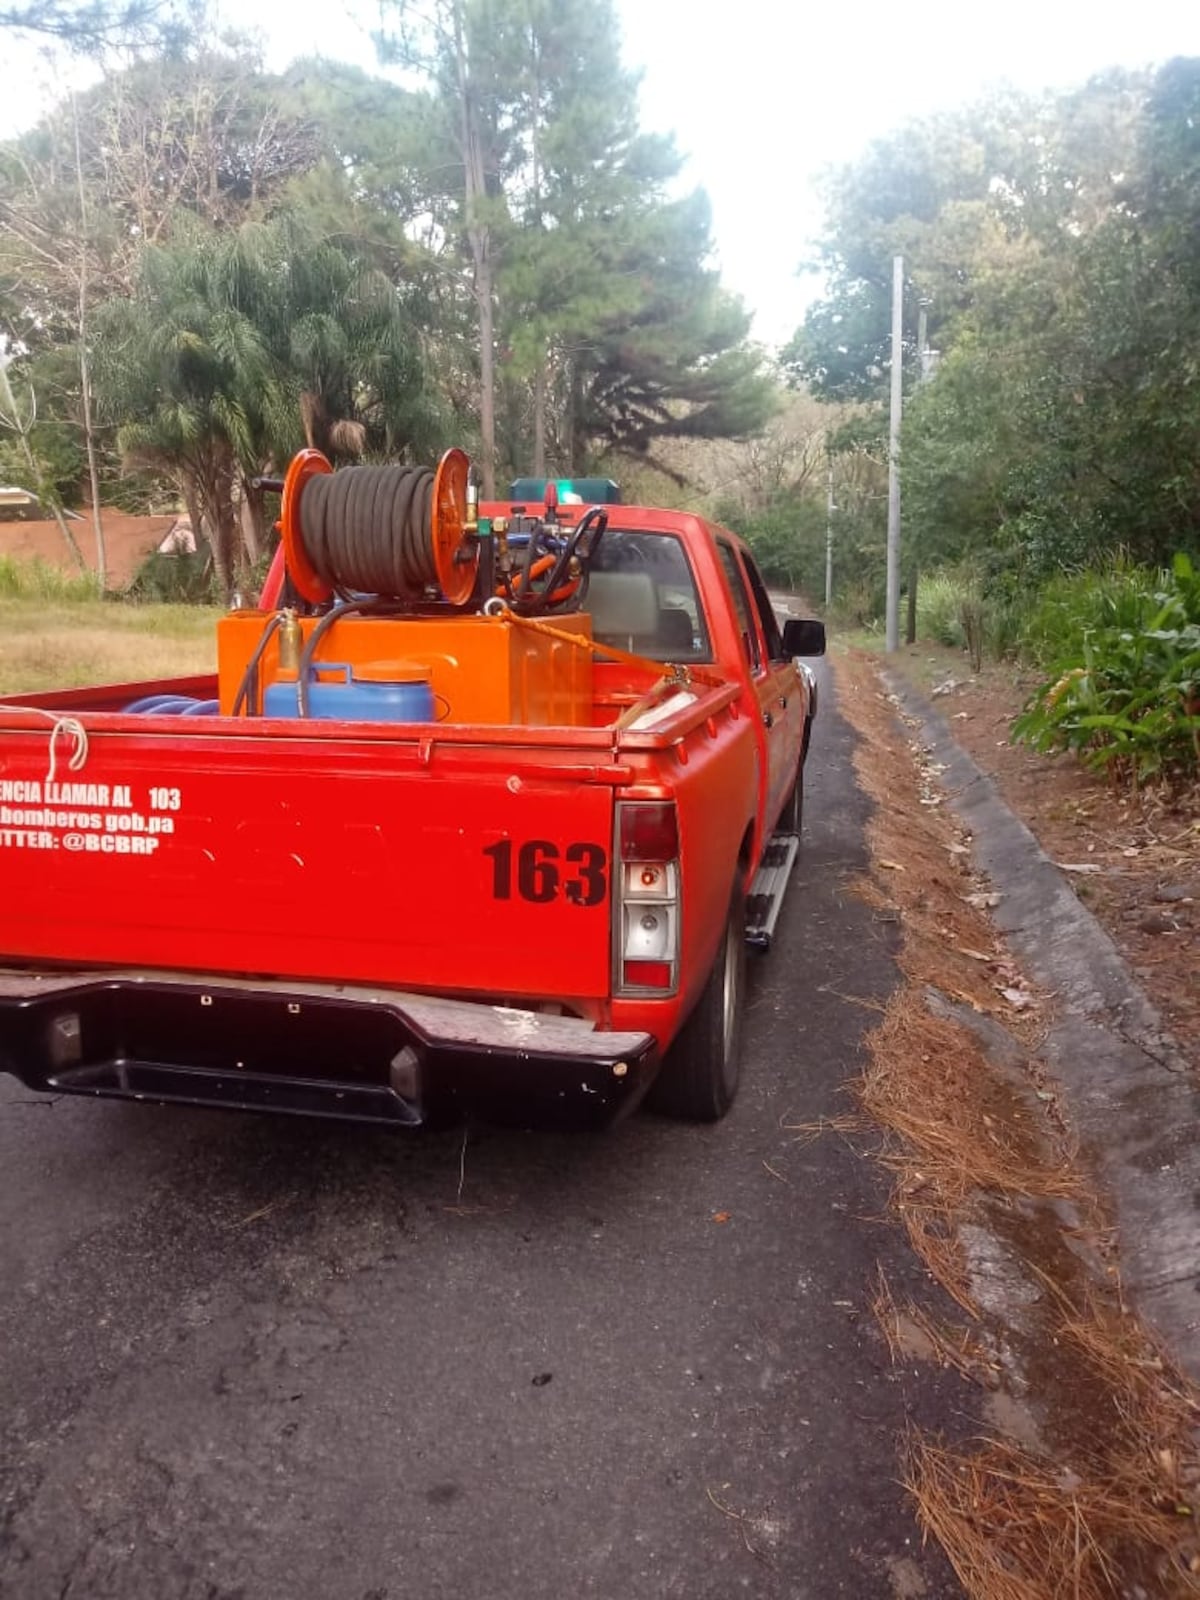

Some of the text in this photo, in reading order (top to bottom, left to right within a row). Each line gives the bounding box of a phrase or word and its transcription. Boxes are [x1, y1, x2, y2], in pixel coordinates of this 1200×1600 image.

[44, 782, 109, 807] LLAMAR
[112, 785, 132, 808] AL
[149, 787, 181, 810] 103
[0, 829, 159, 855] TTER: @BCBRP
[483, 840, 607, 906] 163
